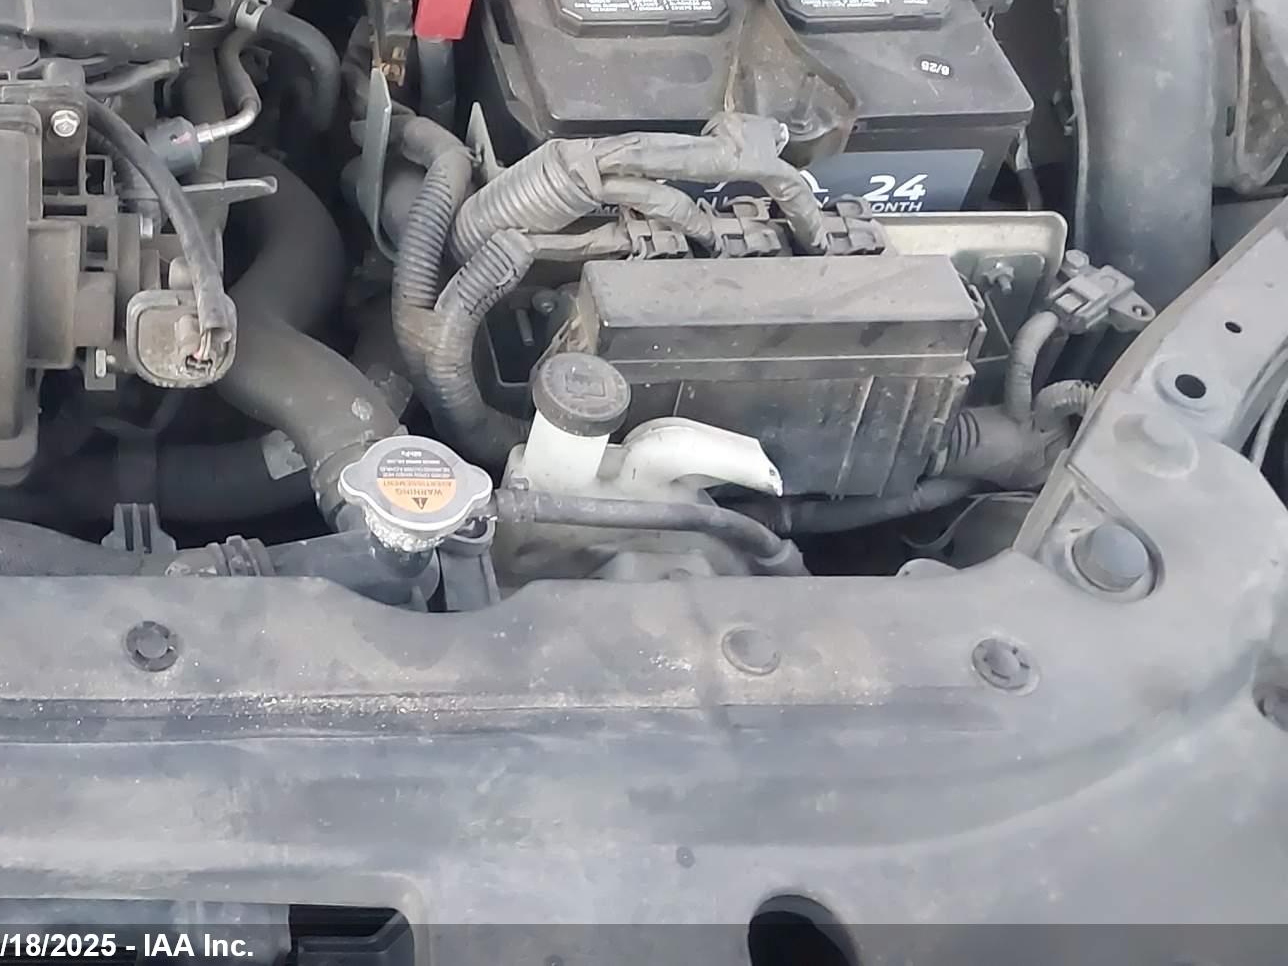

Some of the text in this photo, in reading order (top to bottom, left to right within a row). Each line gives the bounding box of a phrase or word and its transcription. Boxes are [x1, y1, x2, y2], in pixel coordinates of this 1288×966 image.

[862, 174, 928, 202] 24
[871, 201, 923, 212] ONTH
[395, 488, 443, 496] WARNING
